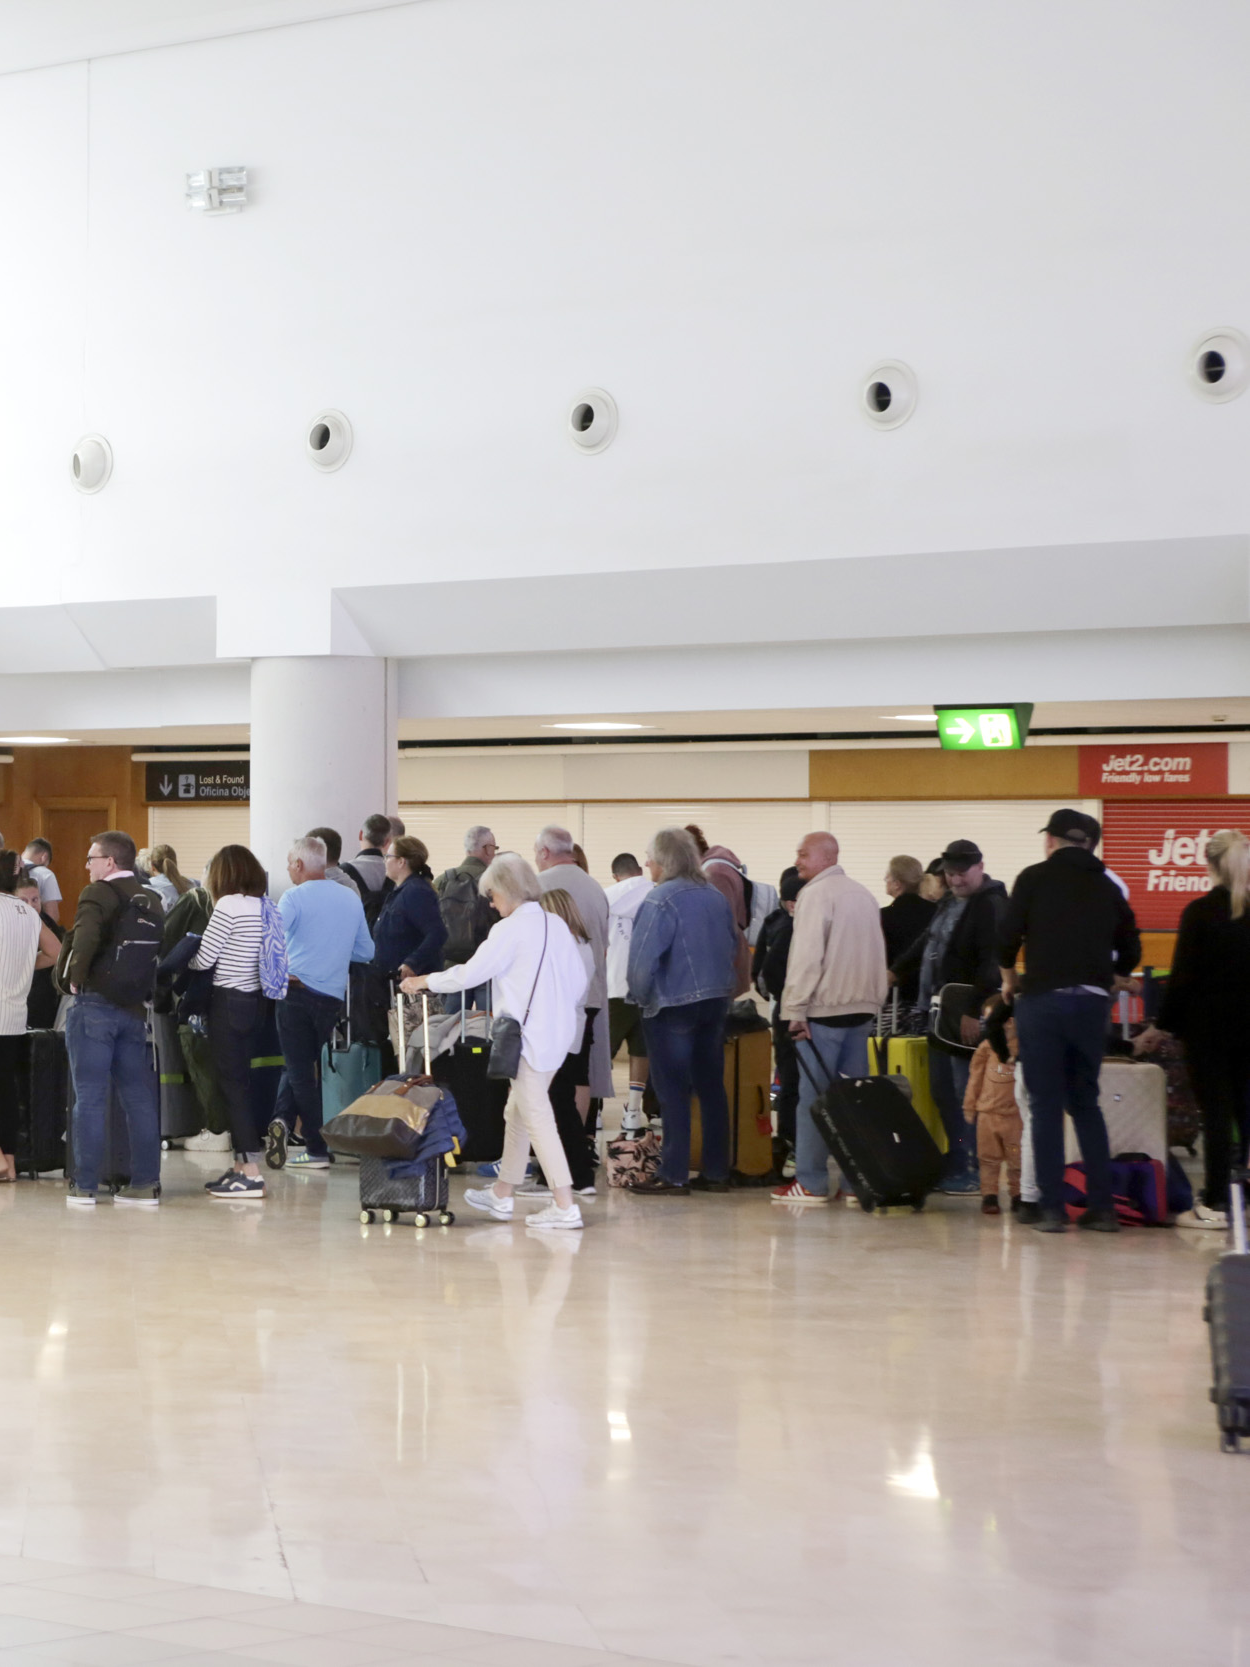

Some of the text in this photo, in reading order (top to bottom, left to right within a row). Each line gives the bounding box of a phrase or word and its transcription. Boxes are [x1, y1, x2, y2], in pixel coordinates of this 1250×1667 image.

[199, 775, 244, 784] Lost & Found
[1101, 772, 1191, 785] Friendly low fares
[199, 786, 229, 796] Oficina
[1148, 828, 1231, 867] Jet
